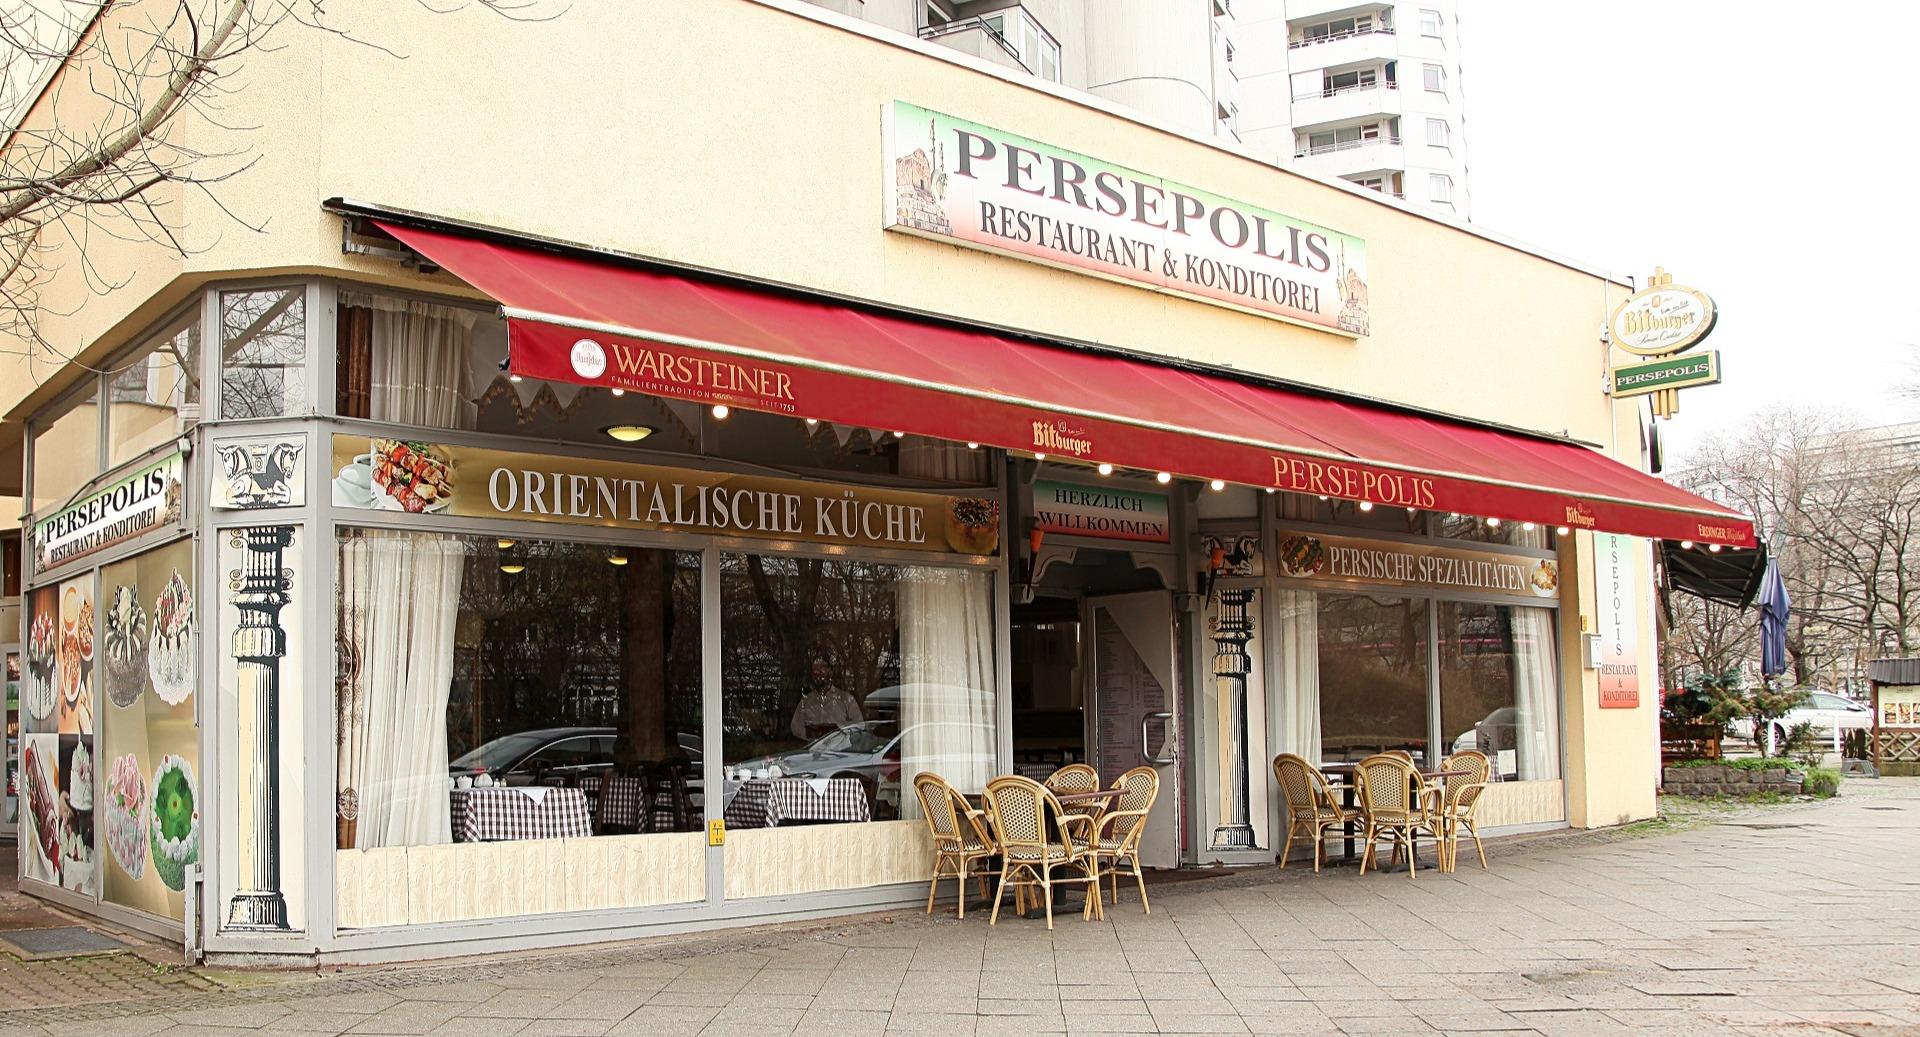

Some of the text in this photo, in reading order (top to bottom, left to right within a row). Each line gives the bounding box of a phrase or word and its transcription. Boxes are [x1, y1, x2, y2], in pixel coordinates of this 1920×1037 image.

[953, 128, 1331, 273] PERSEPOLIS
[980, 200, 1321, 315] RESTAURANT & KONDITOREI
[1623, 308, 1696, 336] Bitburger
[611, 344, 795, 400] WARSTEINER
[611, 375, 710, 399] FAMILIENTRADITION
[779, 402, 795, 412] 1753
[1616, 363, 1709, 386] PERSEPOLIS
[1032, 420, 1092, 456] Bitburger
[1055, 488, 1143, 512] HERZLICH
[1271, 455, 1436, 508] PERSEPOLIS
[45, 466, 164, 544] PERSEPOLIS
[488, 467, 927, 544] ORIENTALISCHE KÜCHE
[1038, 511, 1164, 537] WILLKOMMEN
[1566, 505, 1595, 528] Bitburger
[50, 506, 157, 564] RESTAURANT & KONDITOREI
[1329, 546, 1526, 591] PERSISCHE SPEZIALITÄTEN
[1610, 535, 1623, 657] RSEPOLIS
[1601, 664, 1637, 675] RESTAURANT
